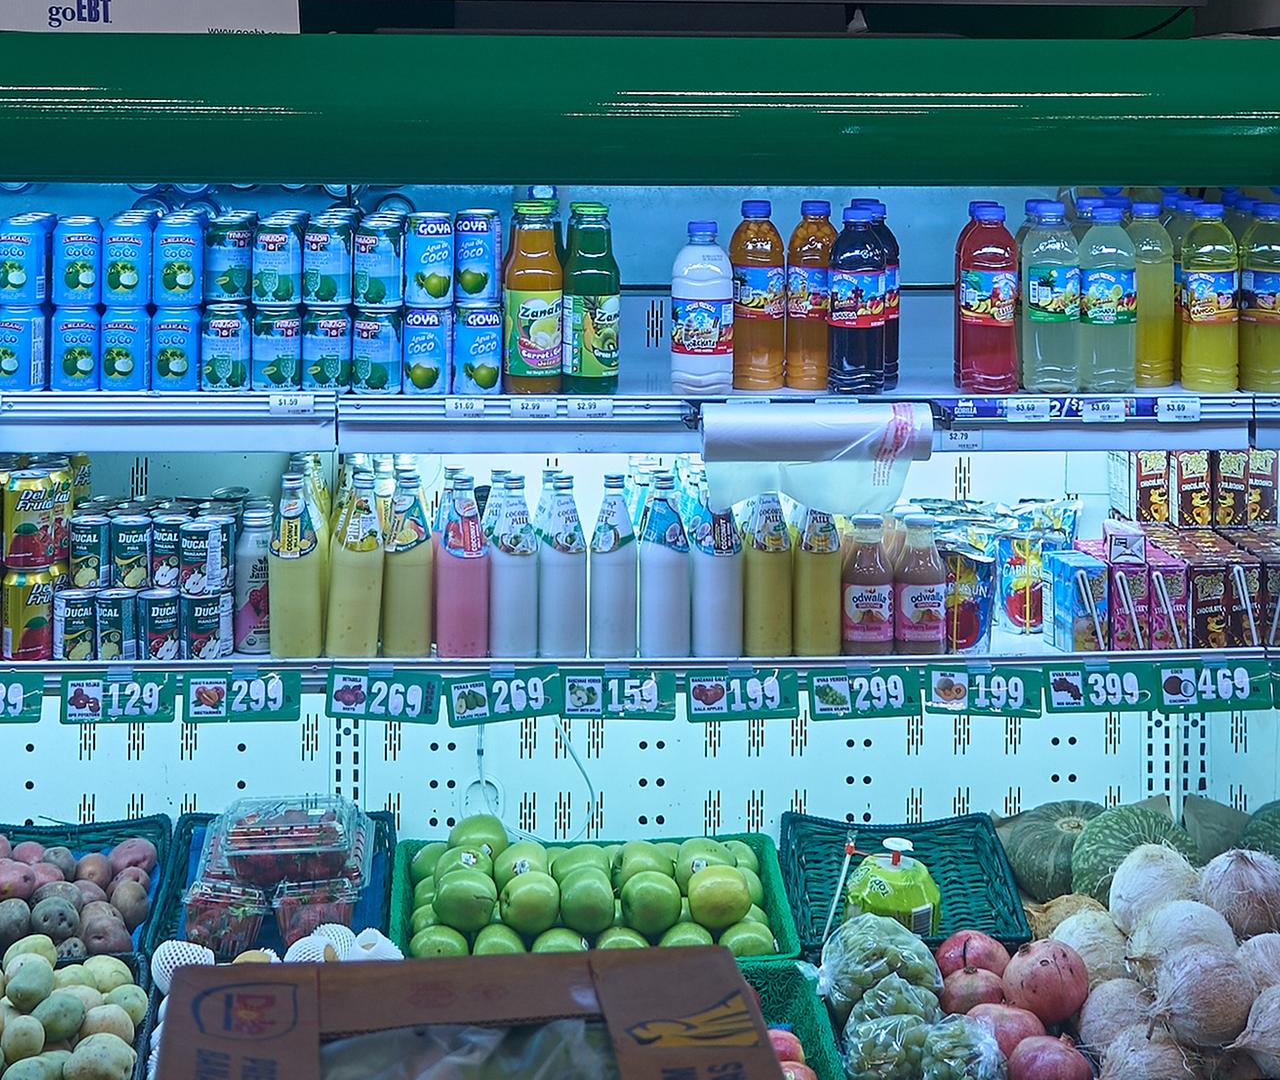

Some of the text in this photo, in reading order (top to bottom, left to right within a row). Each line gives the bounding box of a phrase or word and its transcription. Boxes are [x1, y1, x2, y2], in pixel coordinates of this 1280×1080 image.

[420, 223, 452, 234] GOYA
[457, 220, 488, 232] GOYA
[407, 314, 439, 326] GOYA
[468, 314, 500, 326] GOYA
[278, 398, 298, 406] $1.59
[520, 402, 541, 411] $2.99
[576, 402, 597, 410] $2.99
[954, 406, 977, 414] GORILLA
[949, 432, 969, 441] $2.79
[71, 533, 98, 544] DUCAL
[118, 532, 148, 544] DUCAL
[153, 532, 179, 543] DUCAL
[286, 520, 294, 553] COCONUT
[469, 520, 477, 553] COCONUT
[721, 518, 729, 551] COCONUT
[181, 537, 209, 550] DUCAL
[851, 591, 887, 604] odwalla
[910, 591, 943, 604] odwalla
[64, 606, 93, 618] DUCAL
[1088, 672, 1139, 706] 399
[1198, 667, 1250, 700] 469
[231, 680, 283, 711] 299
[492, 677, 545, 713] 269
[608, 679, 658, 712] 159
[730, 677, 780, 711] 199
[853, 675, 905, 710] 299
[975, 675, 1024, 710] 199
[107, 682, 159, 717] 129
[369, 681, 422, 718] 269
